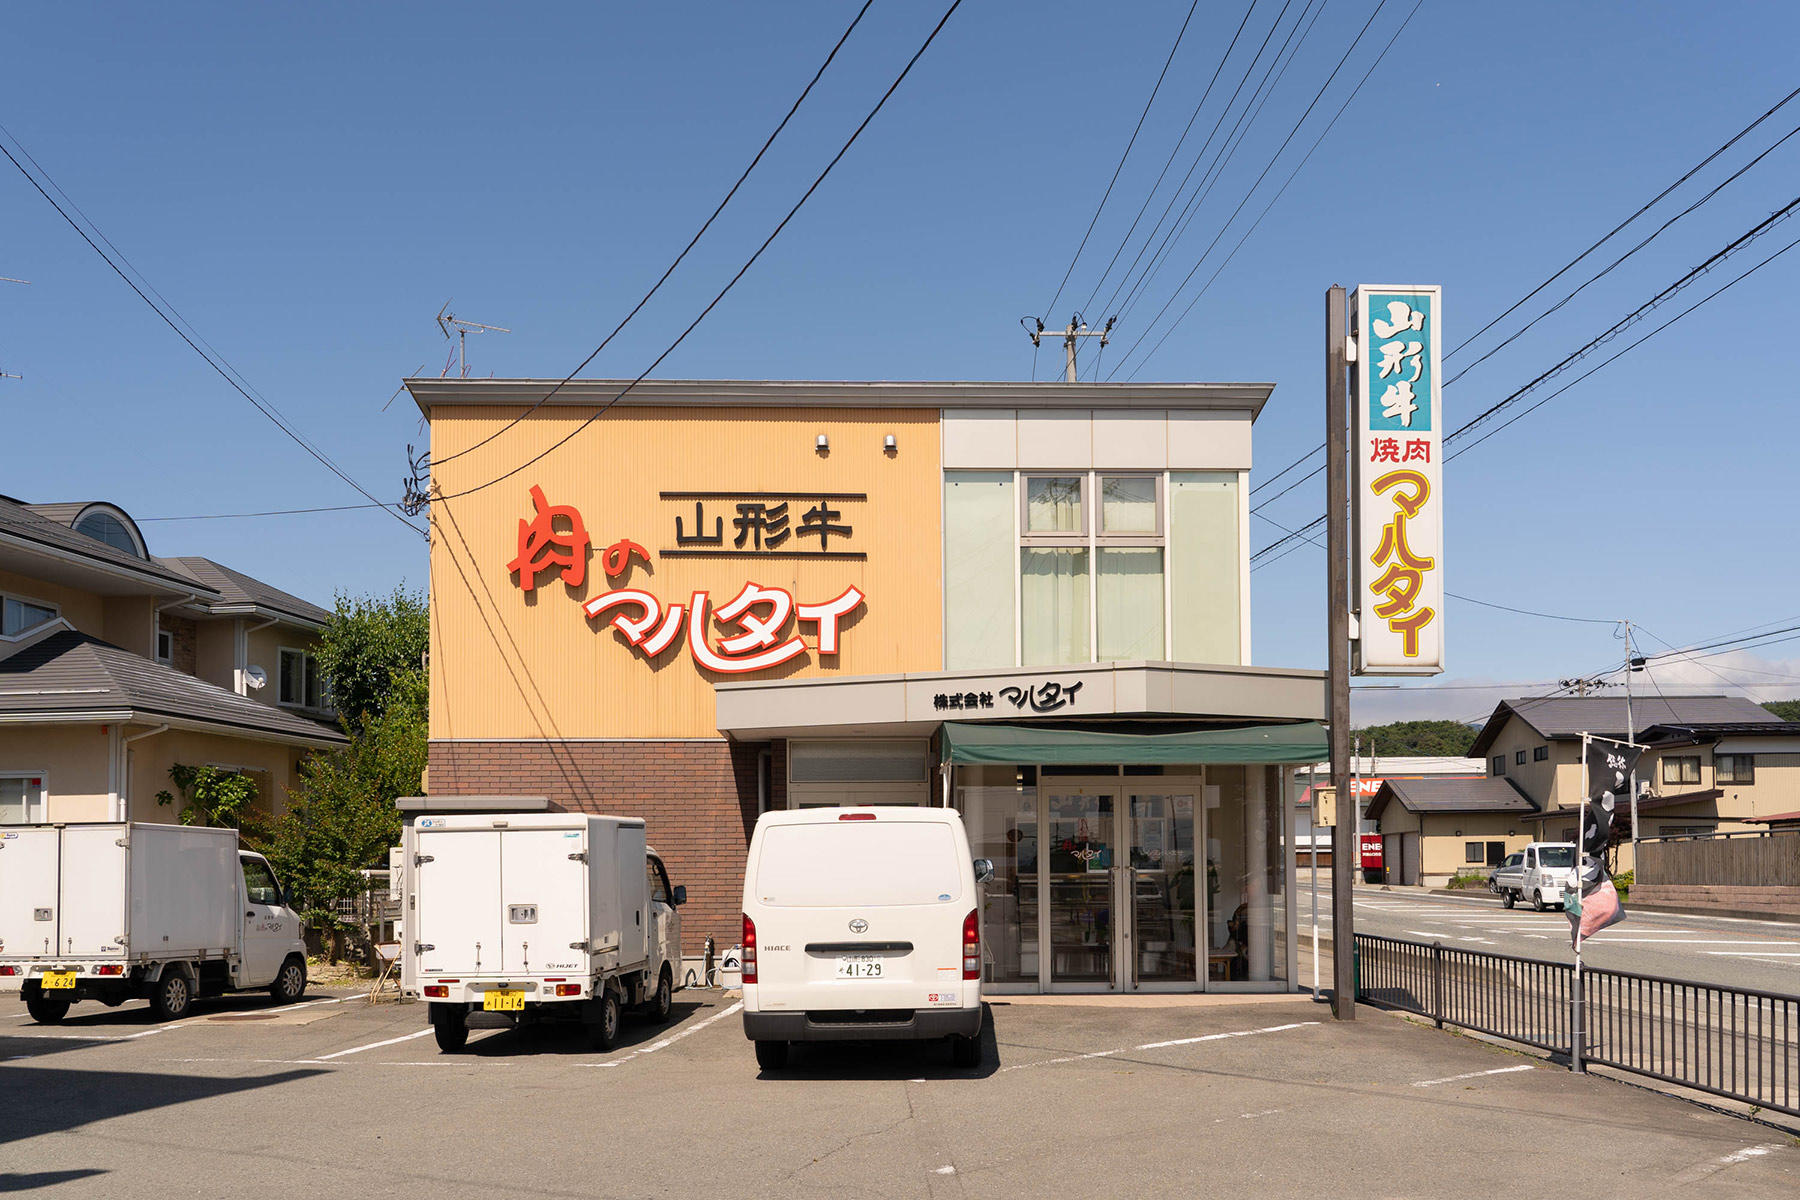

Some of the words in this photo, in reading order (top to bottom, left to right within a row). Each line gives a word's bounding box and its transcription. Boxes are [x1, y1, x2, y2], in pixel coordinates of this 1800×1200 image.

[1372, 300, 1425, 427] 山形牛
[1370, 438, 1431, 464] 焼肉
[506, 484, 651, 591] 肉の
[675, 501, 853, 551] 山形牛
[1370, 469, 1435, 657] マルタイ
[582, 581, 866, 673] マルタイ
[933, 691, 994, 711] 株式会社
[999, 680, 1084, 713] マルタイ
[1362, 843, 1383, 851] ENE
